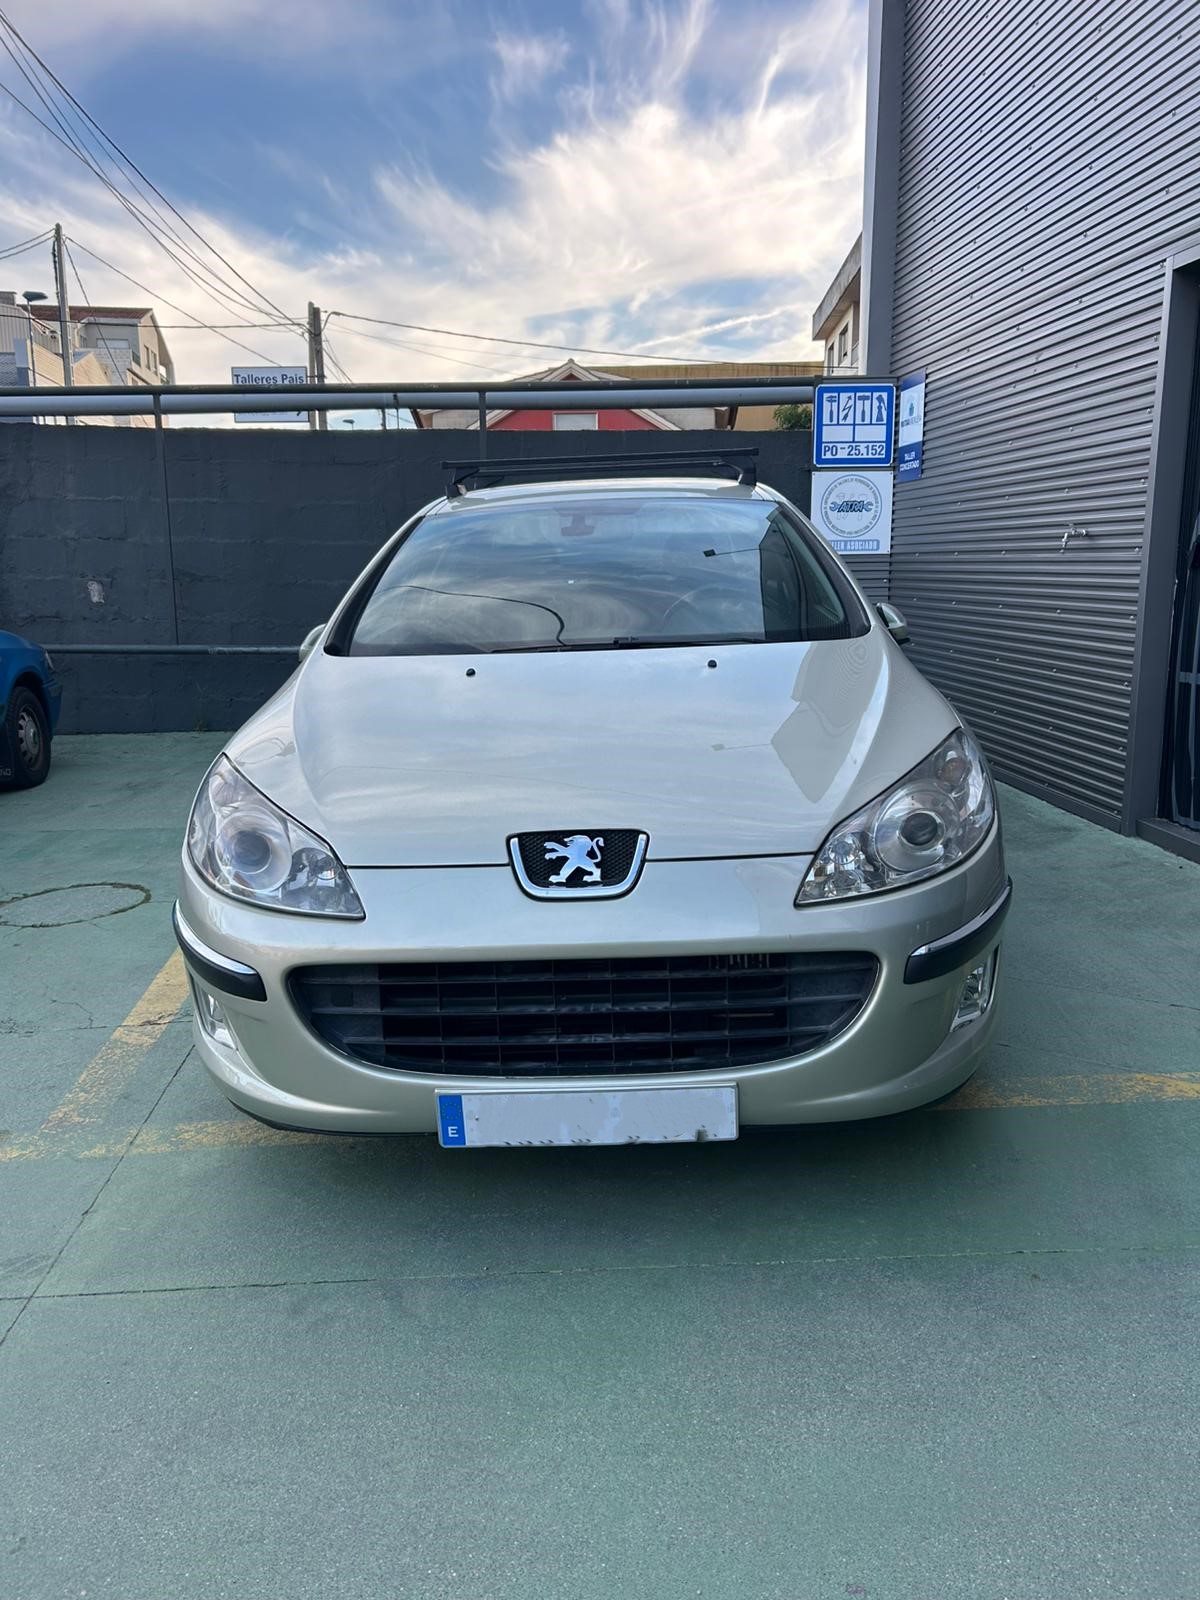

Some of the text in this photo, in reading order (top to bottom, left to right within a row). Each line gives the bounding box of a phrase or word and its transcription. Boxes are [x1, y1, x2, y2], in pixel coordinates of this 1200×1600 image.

[234, 374, 277, 384] Talleres
[847, 540, 877, 550] ASOCIADO
[448, 1126, 459, 1137] E
